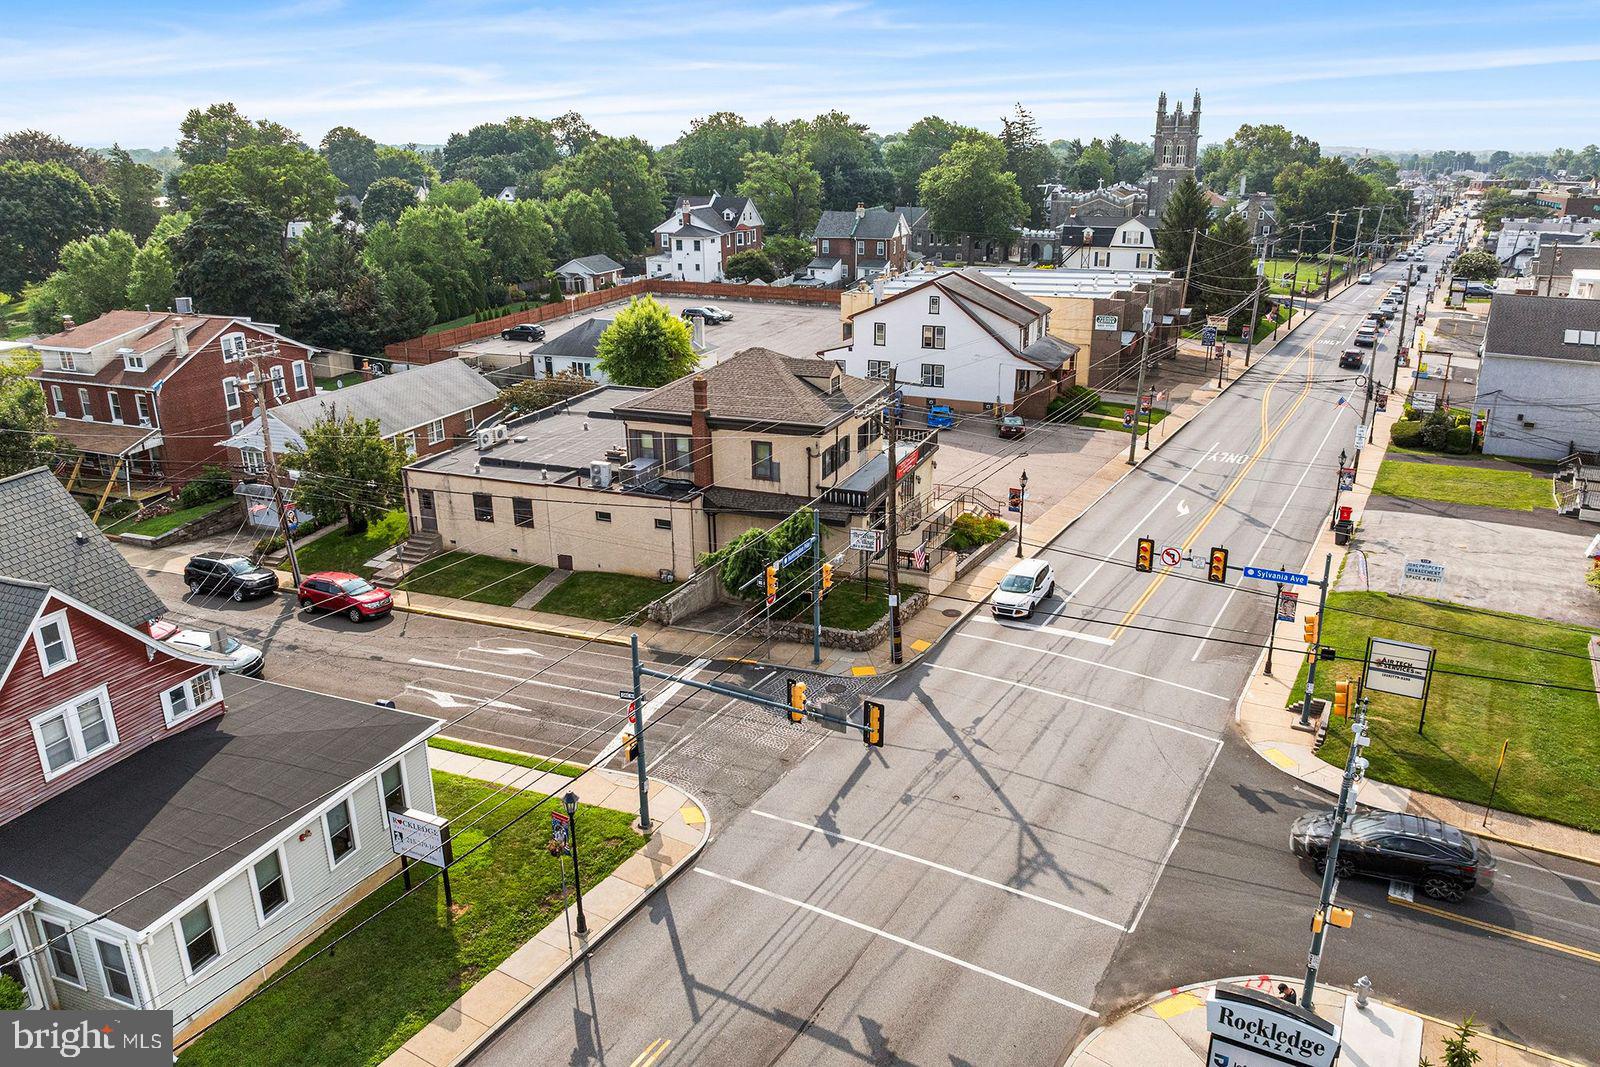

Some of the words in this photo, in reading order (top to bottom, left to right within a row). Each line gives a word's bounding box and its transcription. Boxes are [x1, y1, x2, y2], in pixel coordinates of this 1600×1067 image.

[1208, 451, 1249, 464] ONLY
[1257, 570, 1288, 580] Sylvania
[1290, 575, 1304, 583] Ave
[1384, 664, 1414, 674] SERVICES
[1218, 1006, 1325, 1058] Rockledge
[1243, 1033, 1293, 1056] PLAZA
